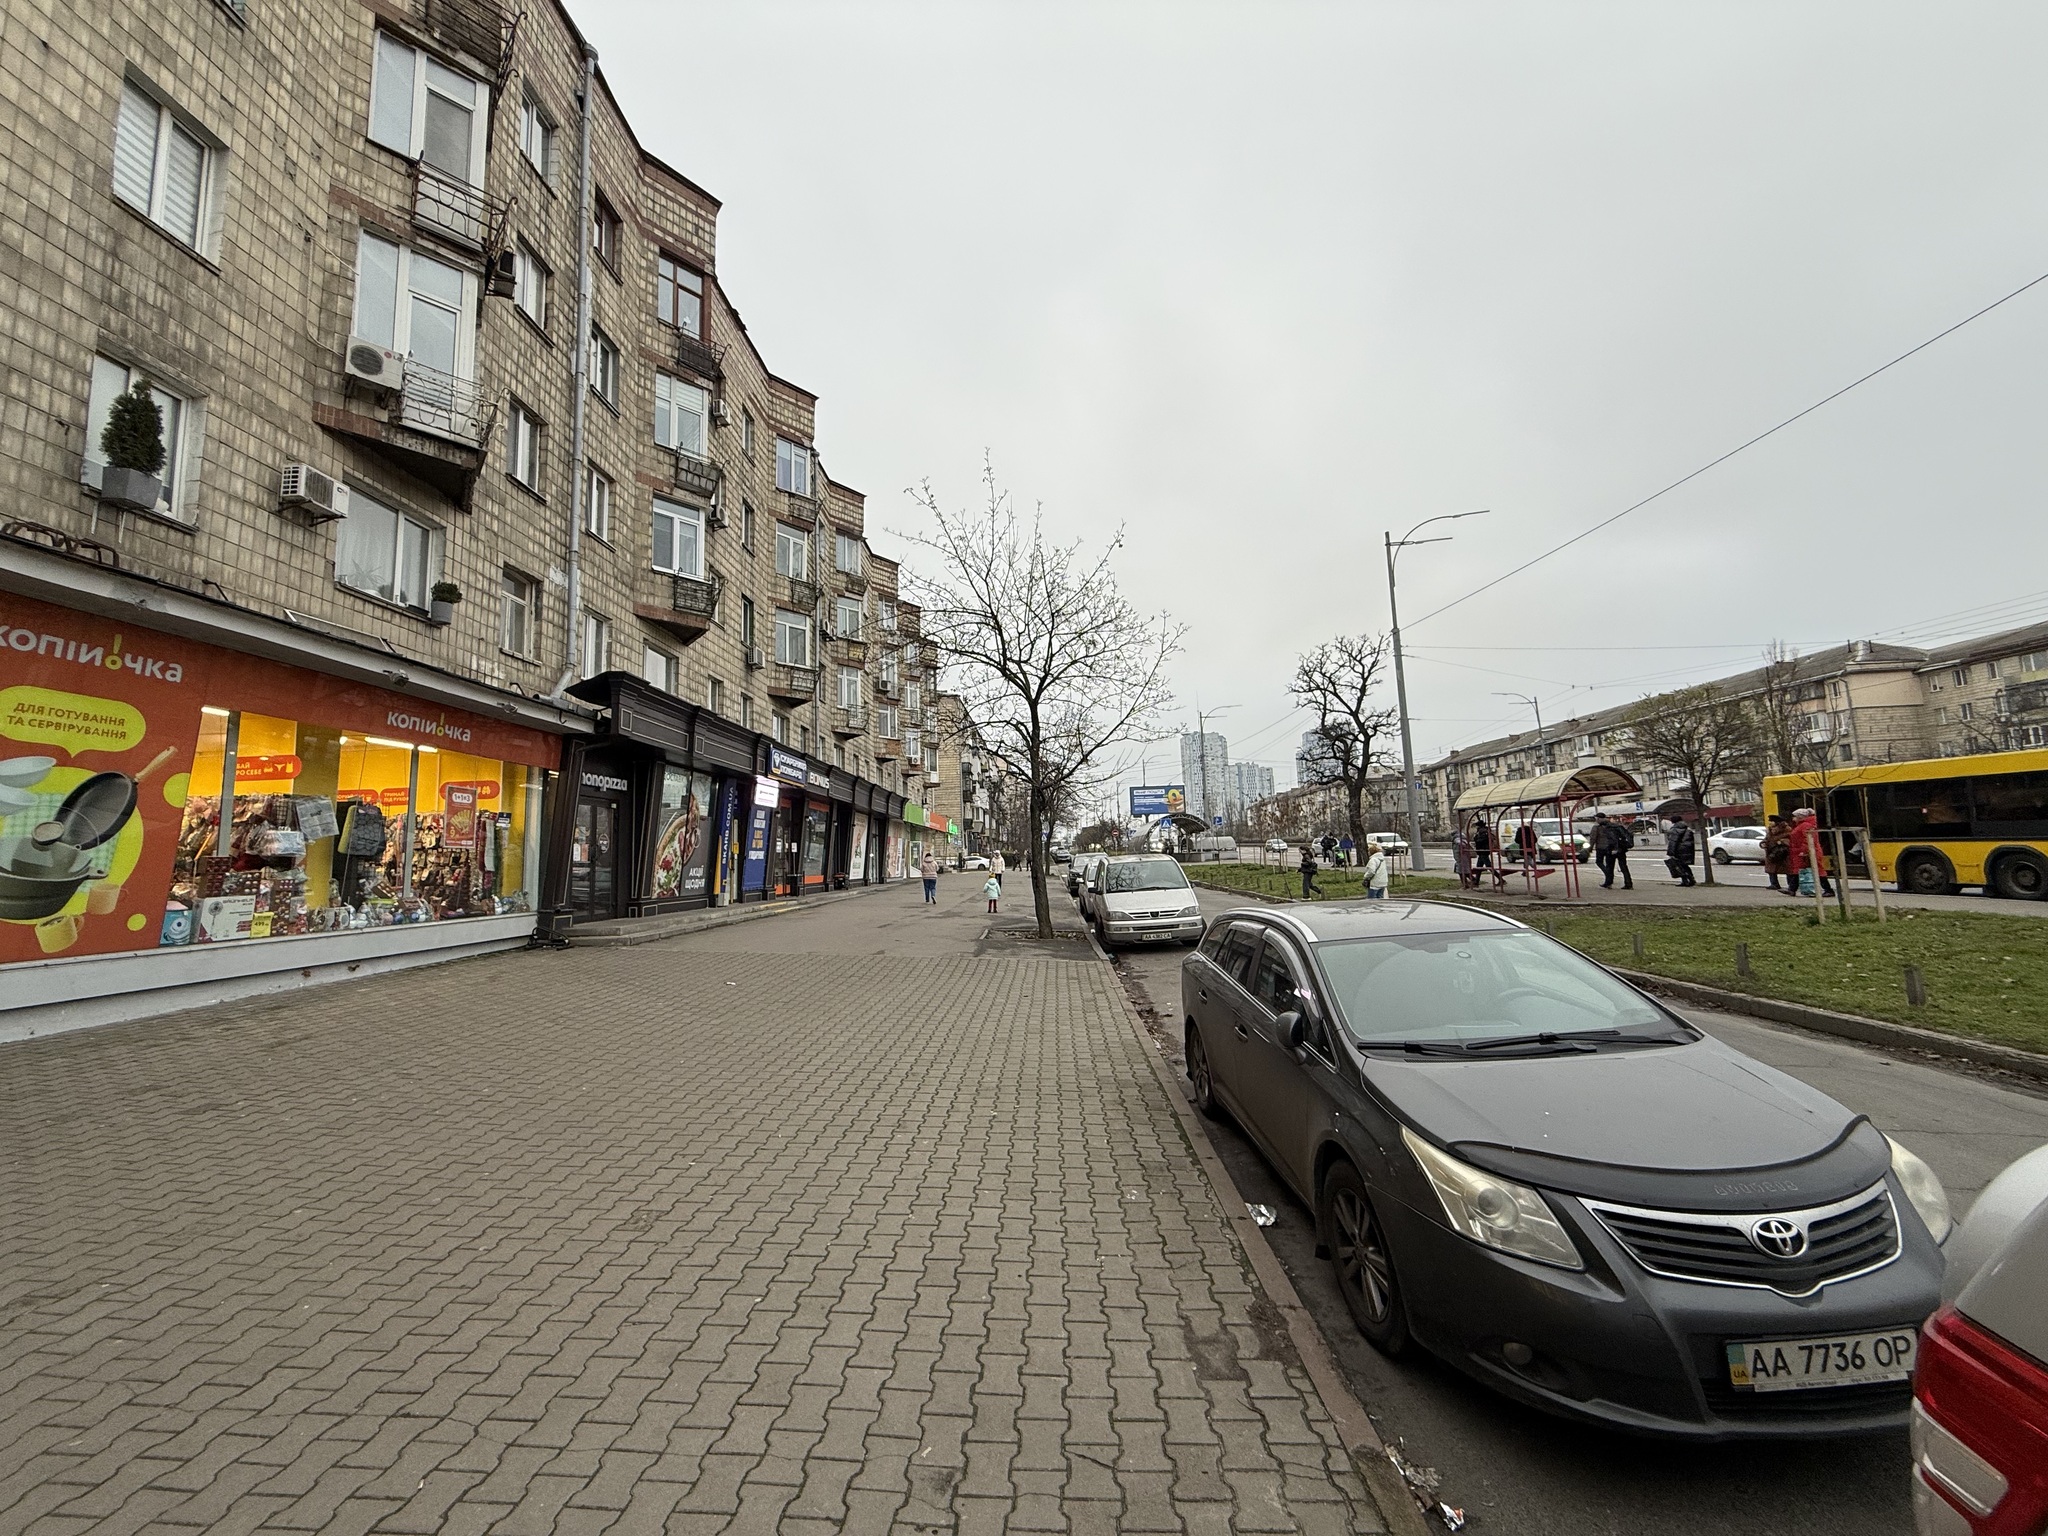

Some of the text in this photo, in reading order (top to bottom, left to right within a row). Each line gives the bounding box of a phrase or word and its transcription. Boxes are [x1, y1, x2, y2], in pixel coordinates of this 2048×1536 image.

[13, 702, 126, 727] ДЛЯ ГОТУВАННЯ
[7, 715, 127, 740] ТА СЕРВІРУВАННЯ
[809, 771, 830, 789] BONUS
[1751, 1335, 1911, 1379] AA 7736 OP
[1733, 1369, 1748, 1379] UA
